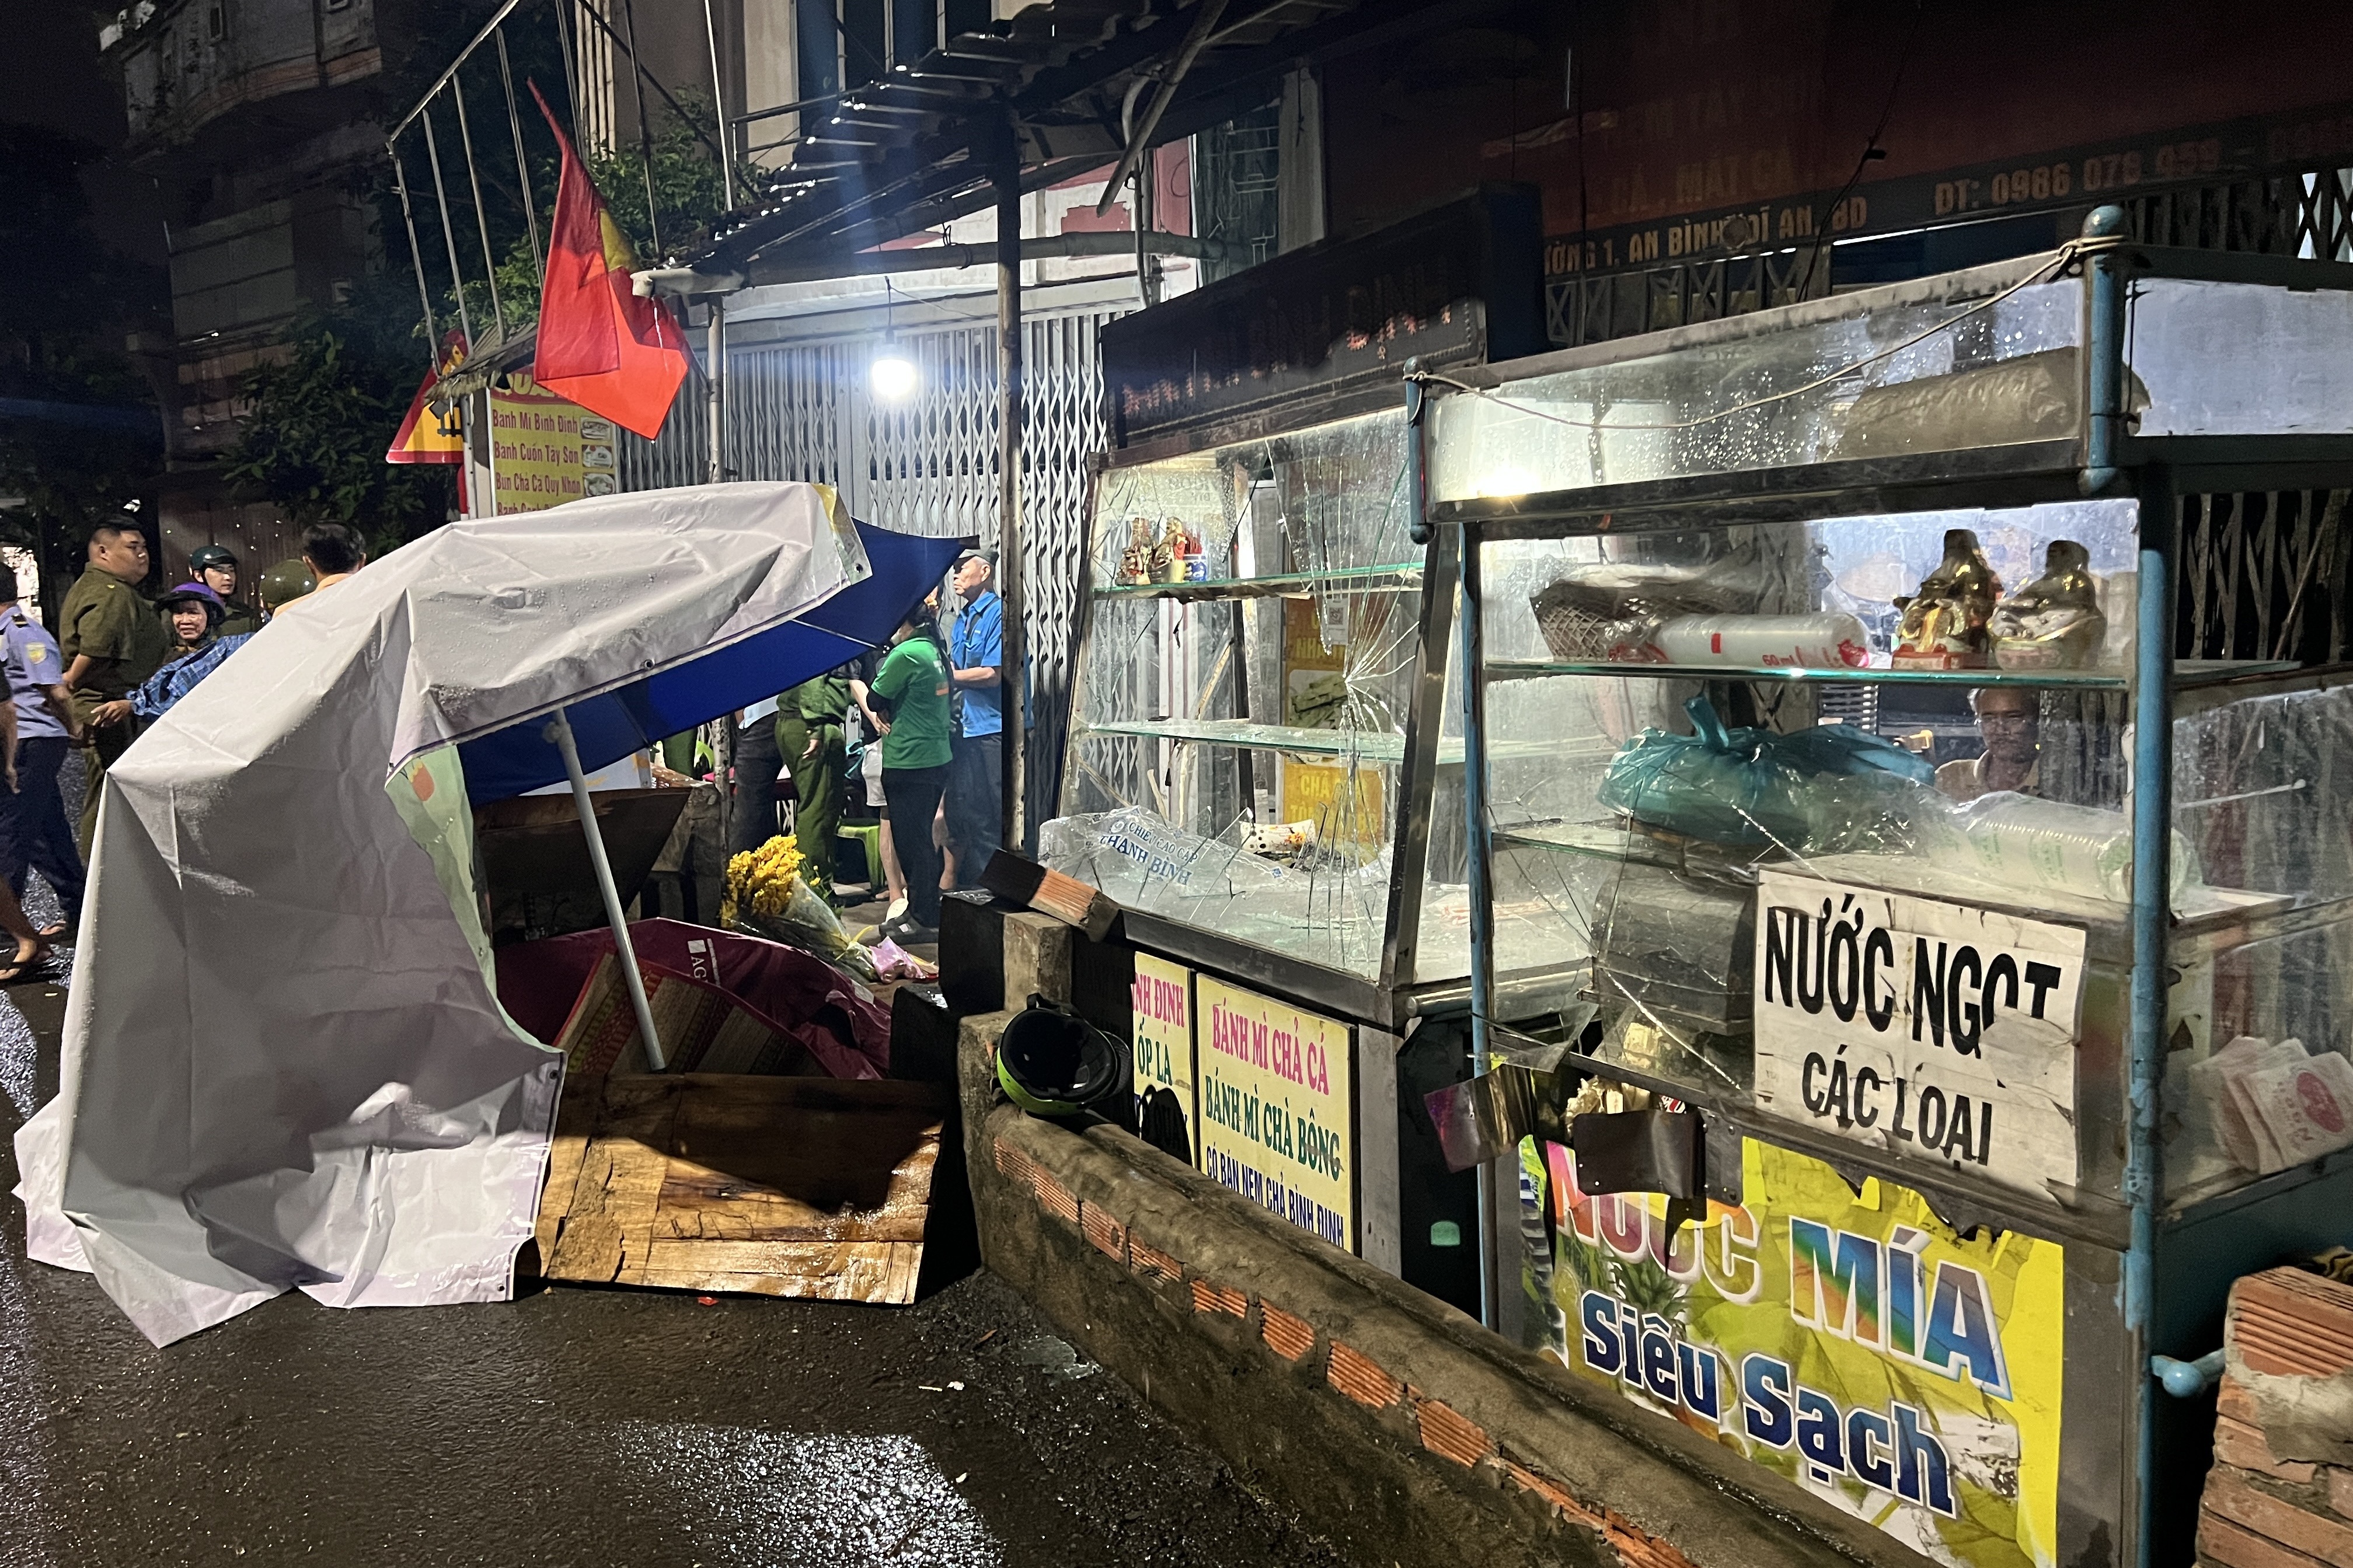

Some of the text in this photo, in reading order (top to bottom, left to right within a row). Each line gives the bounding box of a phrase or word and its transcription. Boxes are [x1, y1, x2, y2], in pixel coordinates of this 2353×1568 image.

[1991, 162, 2072, 205] 0986
[1629, 230, 1658, 263] AN
[1764, 893, 1895, 1032] NƯỚC
[1212, 997, 1329, 1095] BÁNH MÌ CHẢ CÁ
[1205, 1066, 1240, 1133] BÁNH
[1244, 1083, 1260, 1143] MÌ
[1263, 1096, 1294, 1160] CHÀ
[1297, 1107, 1340, 1182] BÔNG
[1801, 1043, 1993, 1171] CÁC LOẠI
[1220, 1148, 1239, 1192] BÁN
[1242, 1163, 1263, 1205] NEM
[1266, 1171, 1286, 1218] CHẢ
[1289, 1183, 1313, 1231] BÌNH
[1787, 1214, 2013, 1401] MÍA
[1578, 1288, 1956, 1520] Siêu Sạch
